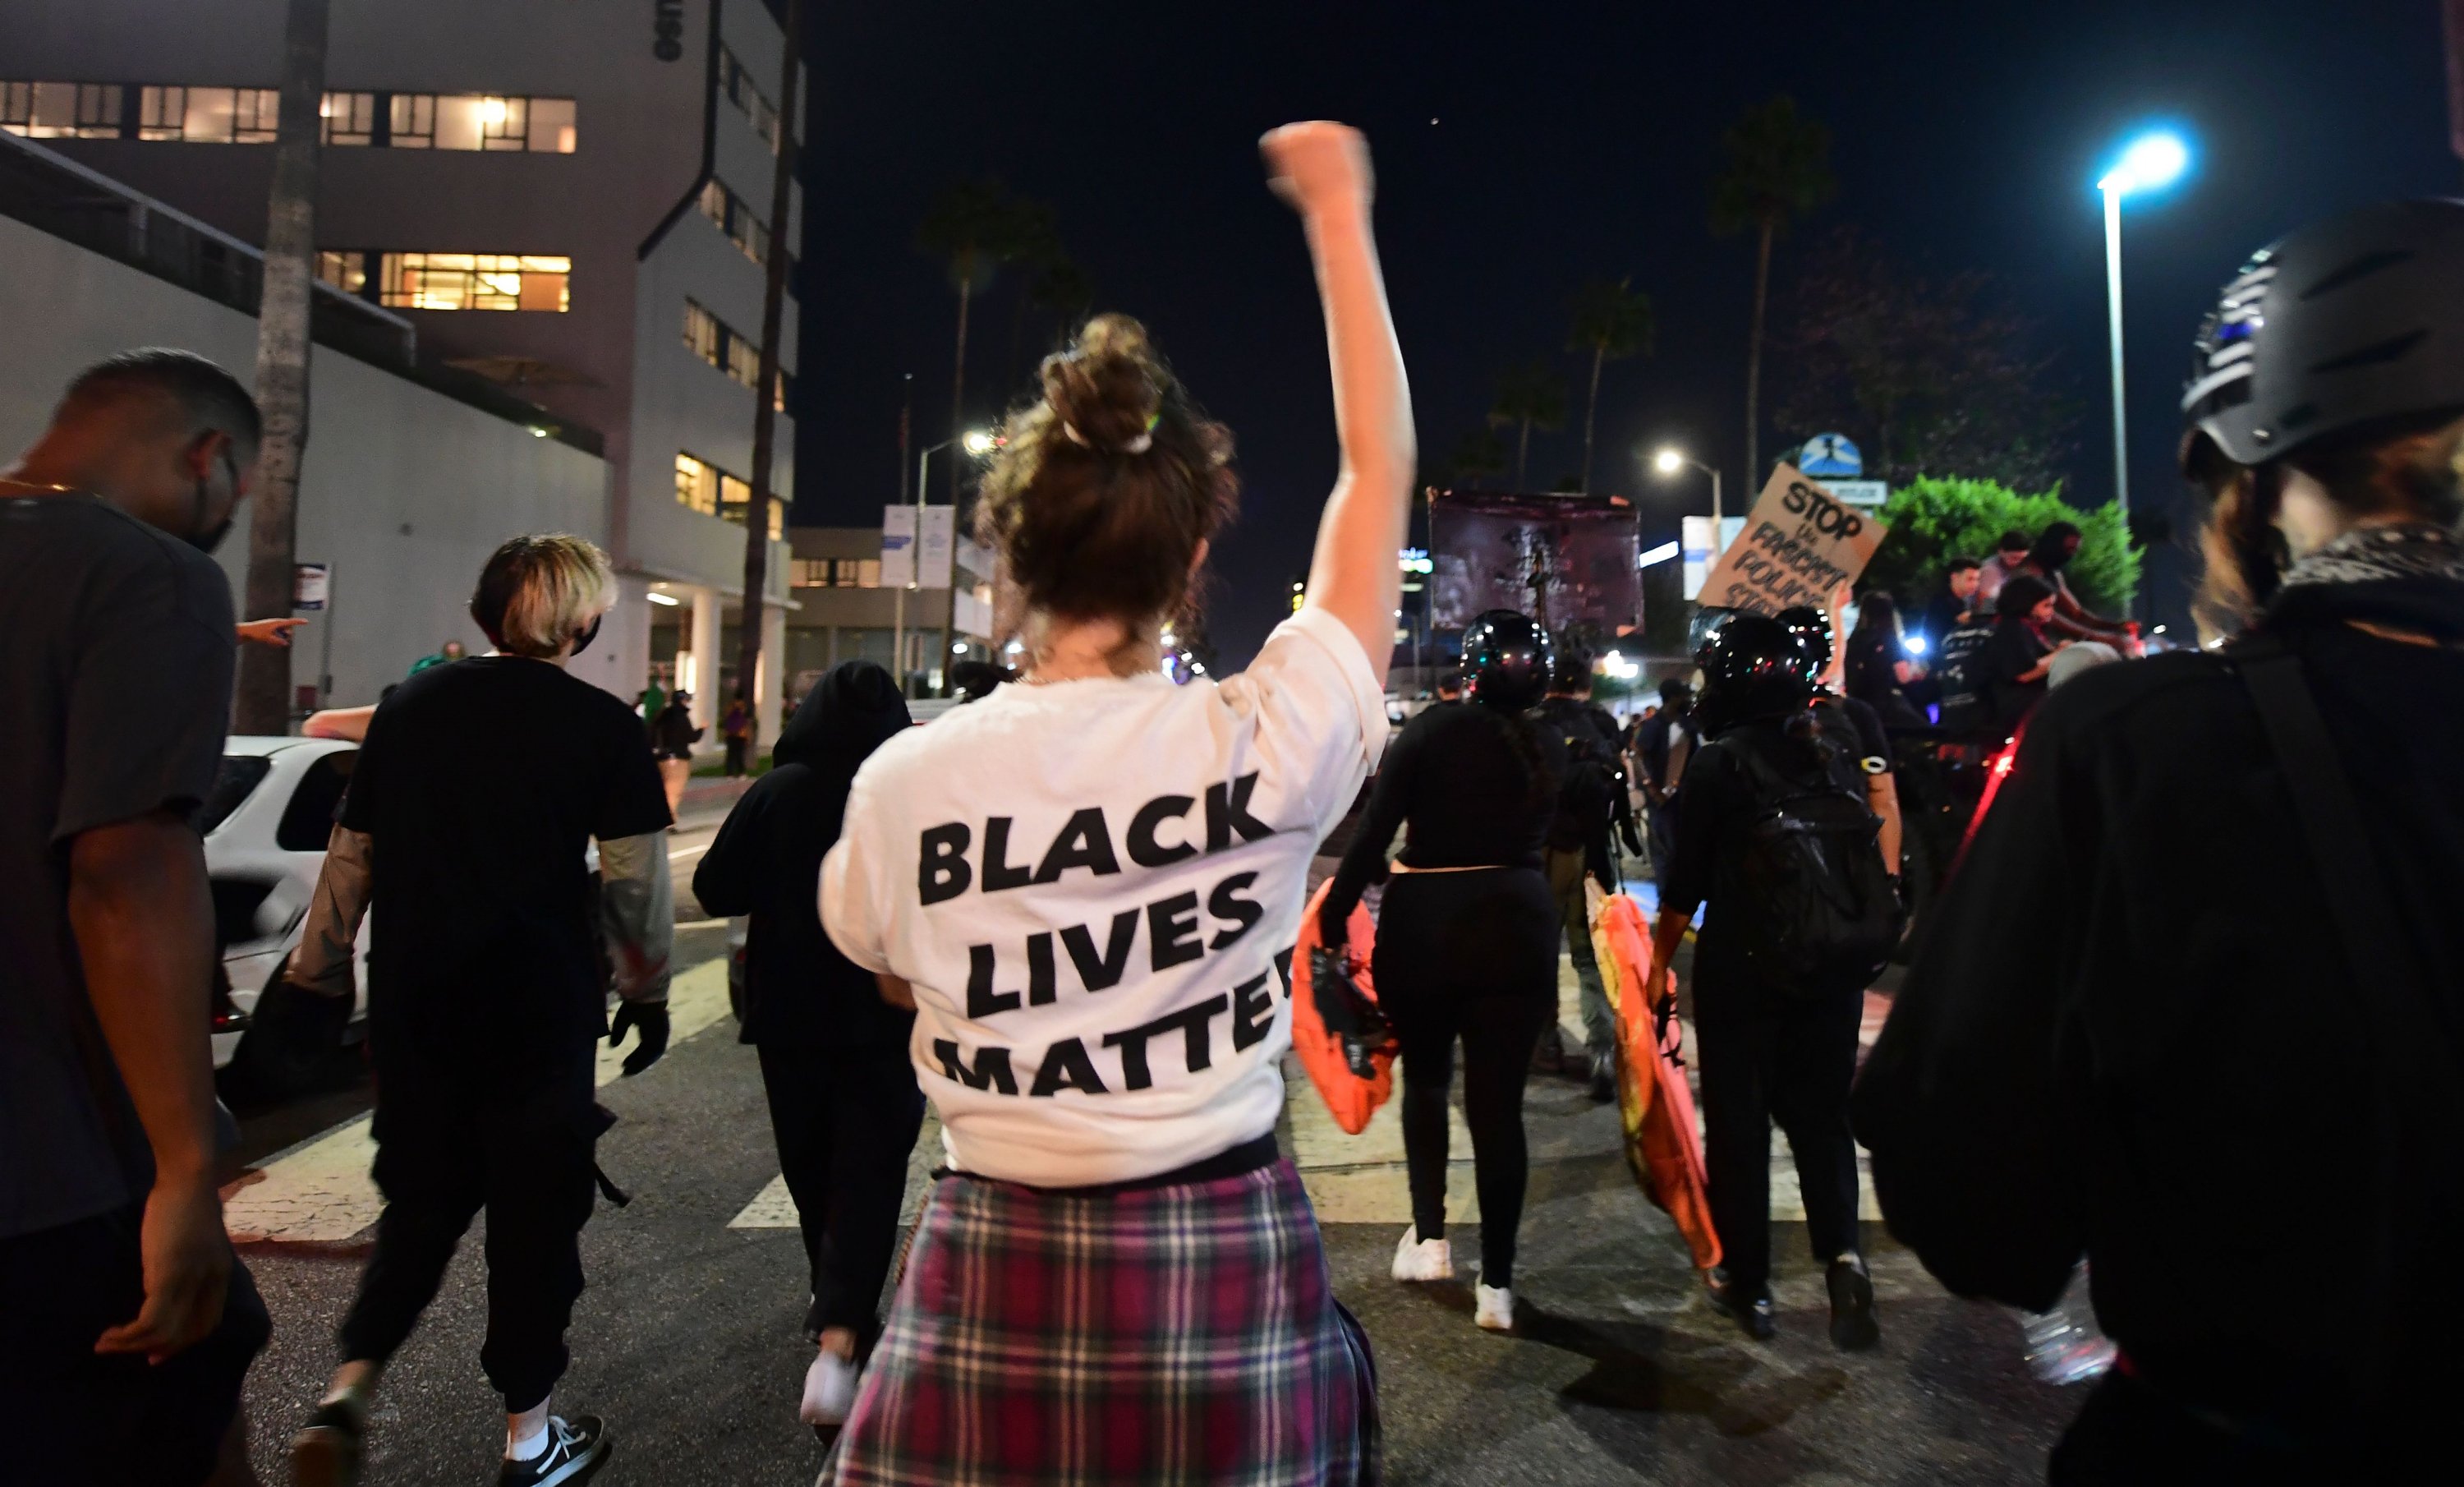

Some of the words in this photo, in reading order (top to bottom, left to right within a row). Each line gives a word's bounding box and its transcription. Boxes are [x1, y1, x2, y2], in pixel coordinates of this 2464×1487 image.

[1749, 521, 1848, 592] FASCIST
[1782, 481, 1862, 541] STOP
[918, 770, 1275, 906] BLACK
[967, 871, 1264, 1019] LIVES
